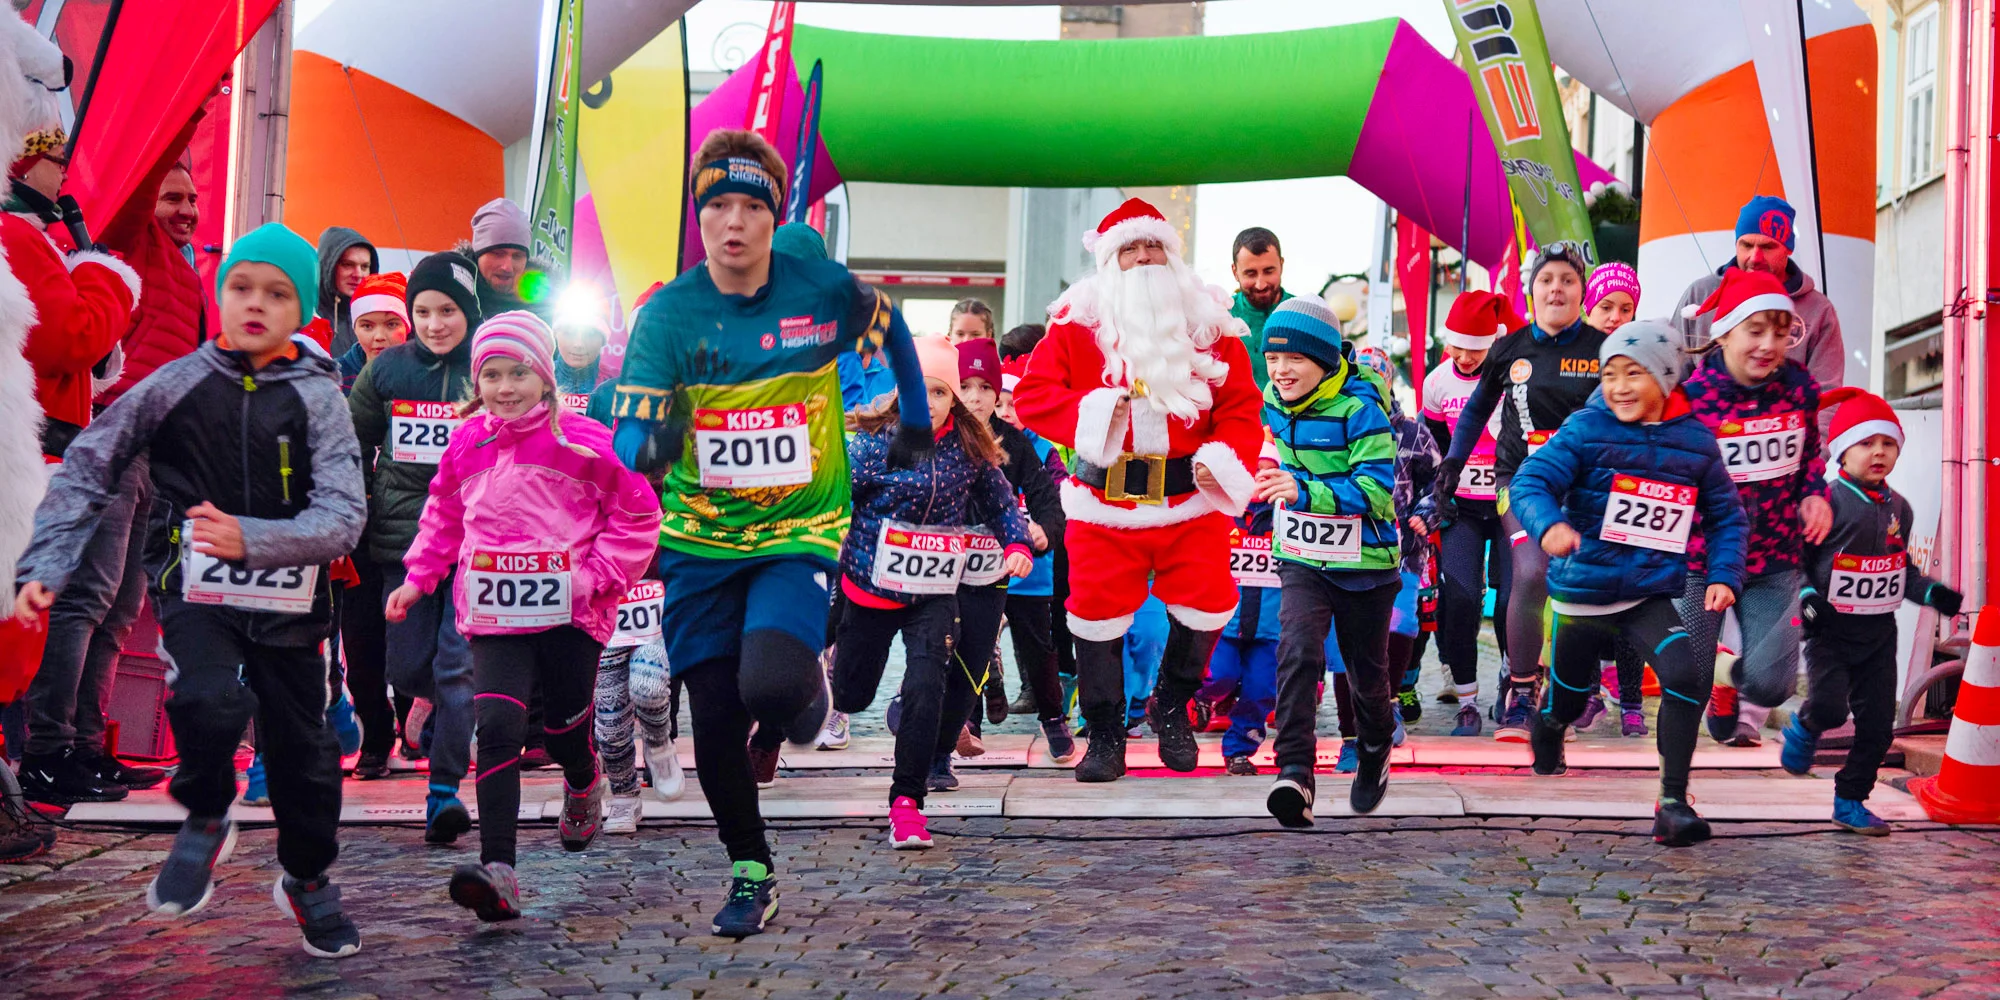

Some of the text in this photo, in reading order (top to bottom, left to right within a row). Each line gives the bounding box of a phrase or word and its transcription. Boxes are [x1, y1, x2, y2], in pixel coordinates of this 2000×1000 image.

[1560, 358, 1599, 373] KIDS
[416, 403, 452, 418] KIDS
[560, 395, 588, 408] KIDS
[727, 409, 775, 430] KIDS
[1744, 417, 1782, 434] KIDS
[399, 422, 456, 447] 228
[708, 434, 796, 467] 2010
[1727, 435, 1797, 465] 2006
[1638, 481, 1675, 500] KIDS
[1613, 499, 1684, 533] 2287
[1286, 516, 1353, 546] 2027
[911, 534, 946, 551] KIDS
[970, 536, 1000, 549] KIDS
[1242, 537, 1271, 549] KIDS
[496, 555, 540, 572] KIDS
[887, 552, 954, 578] 2024
[1860, 557, 1892, 572] KIDS
[477, 578, 560, 607] 2022
[627, 582, 664, 601] KIDS
[1837, 573, 1900, 599] 2026
[618, 603, 661, 631] 201
